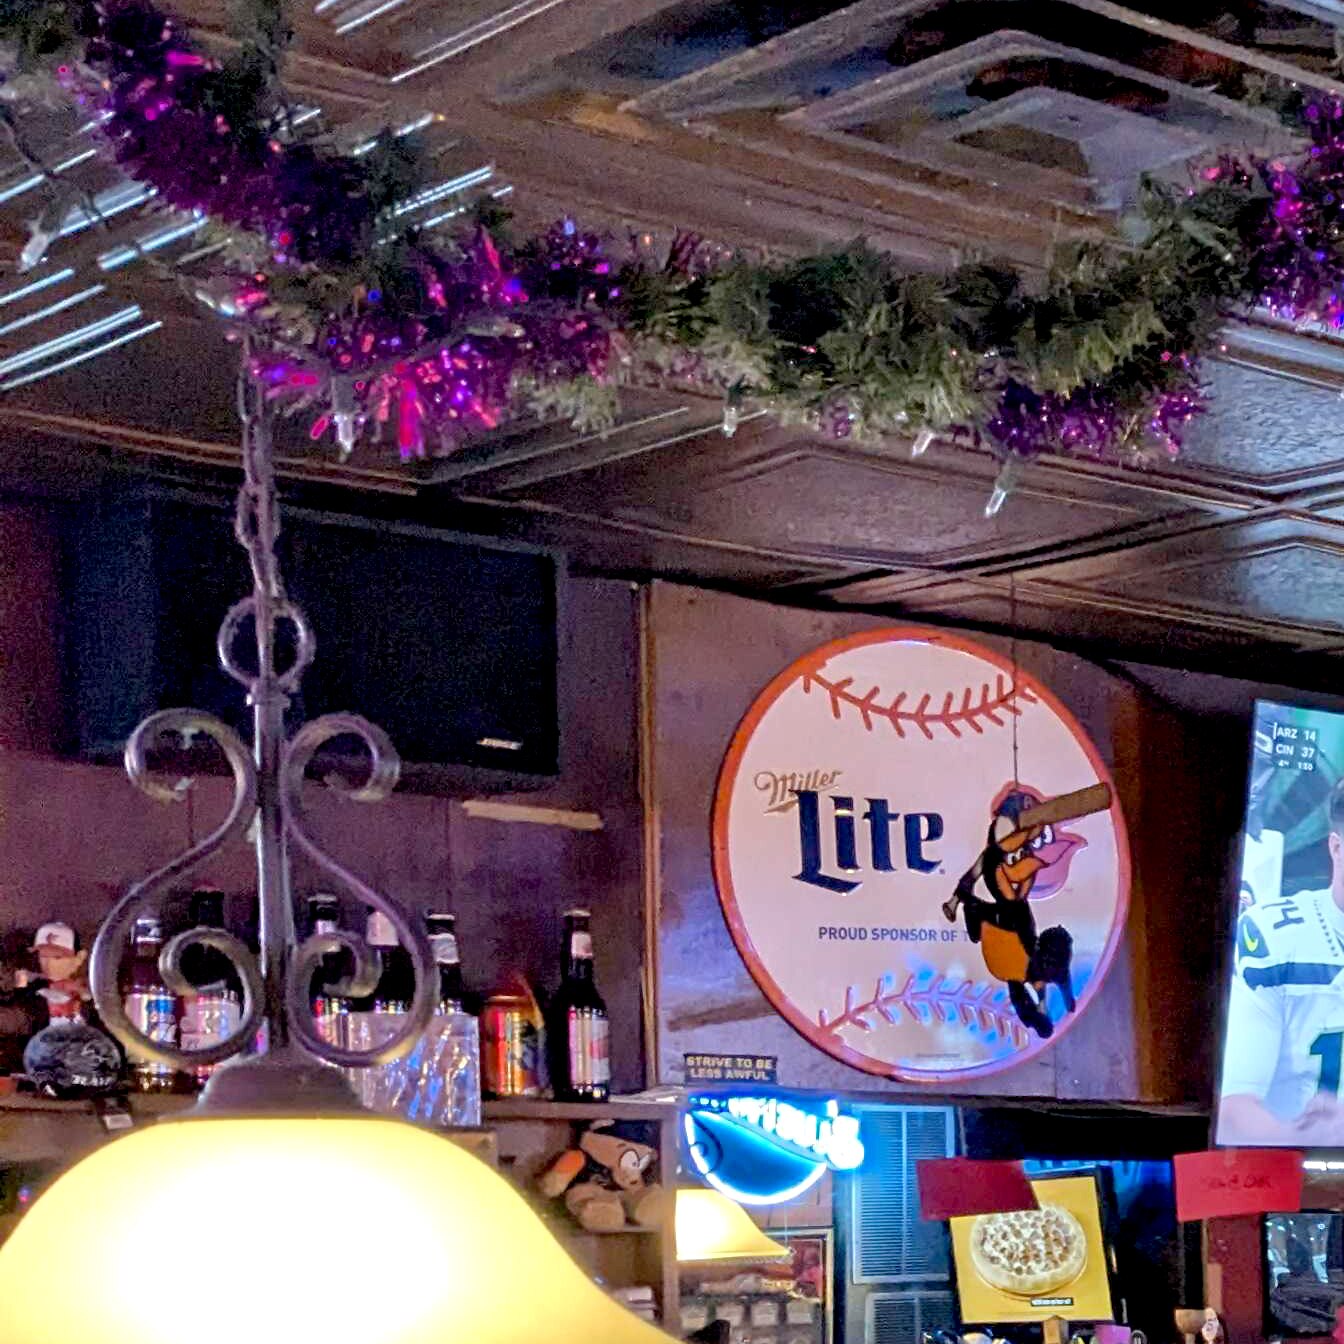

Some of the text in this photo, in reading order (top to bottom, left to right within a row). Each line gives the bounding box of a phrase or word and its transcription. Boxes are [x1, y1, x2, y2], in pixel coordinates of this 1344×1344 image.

[1276, 728, 1317, 742] ARZ 14
[1275, 743, 1315, 759] CIN 37
[754, 769, 843, 807] Miller
[789, 790, 944, 895] Lite
[818, 926, 868, 941] PROUD
[871, 928, 938, 942] SPONSOR
[940, 930, 958, 942] OF
[686, 1056, 774, 1070] STRIVE TO BE
[690, 1068, 769, 1081] LESS AWFUL
